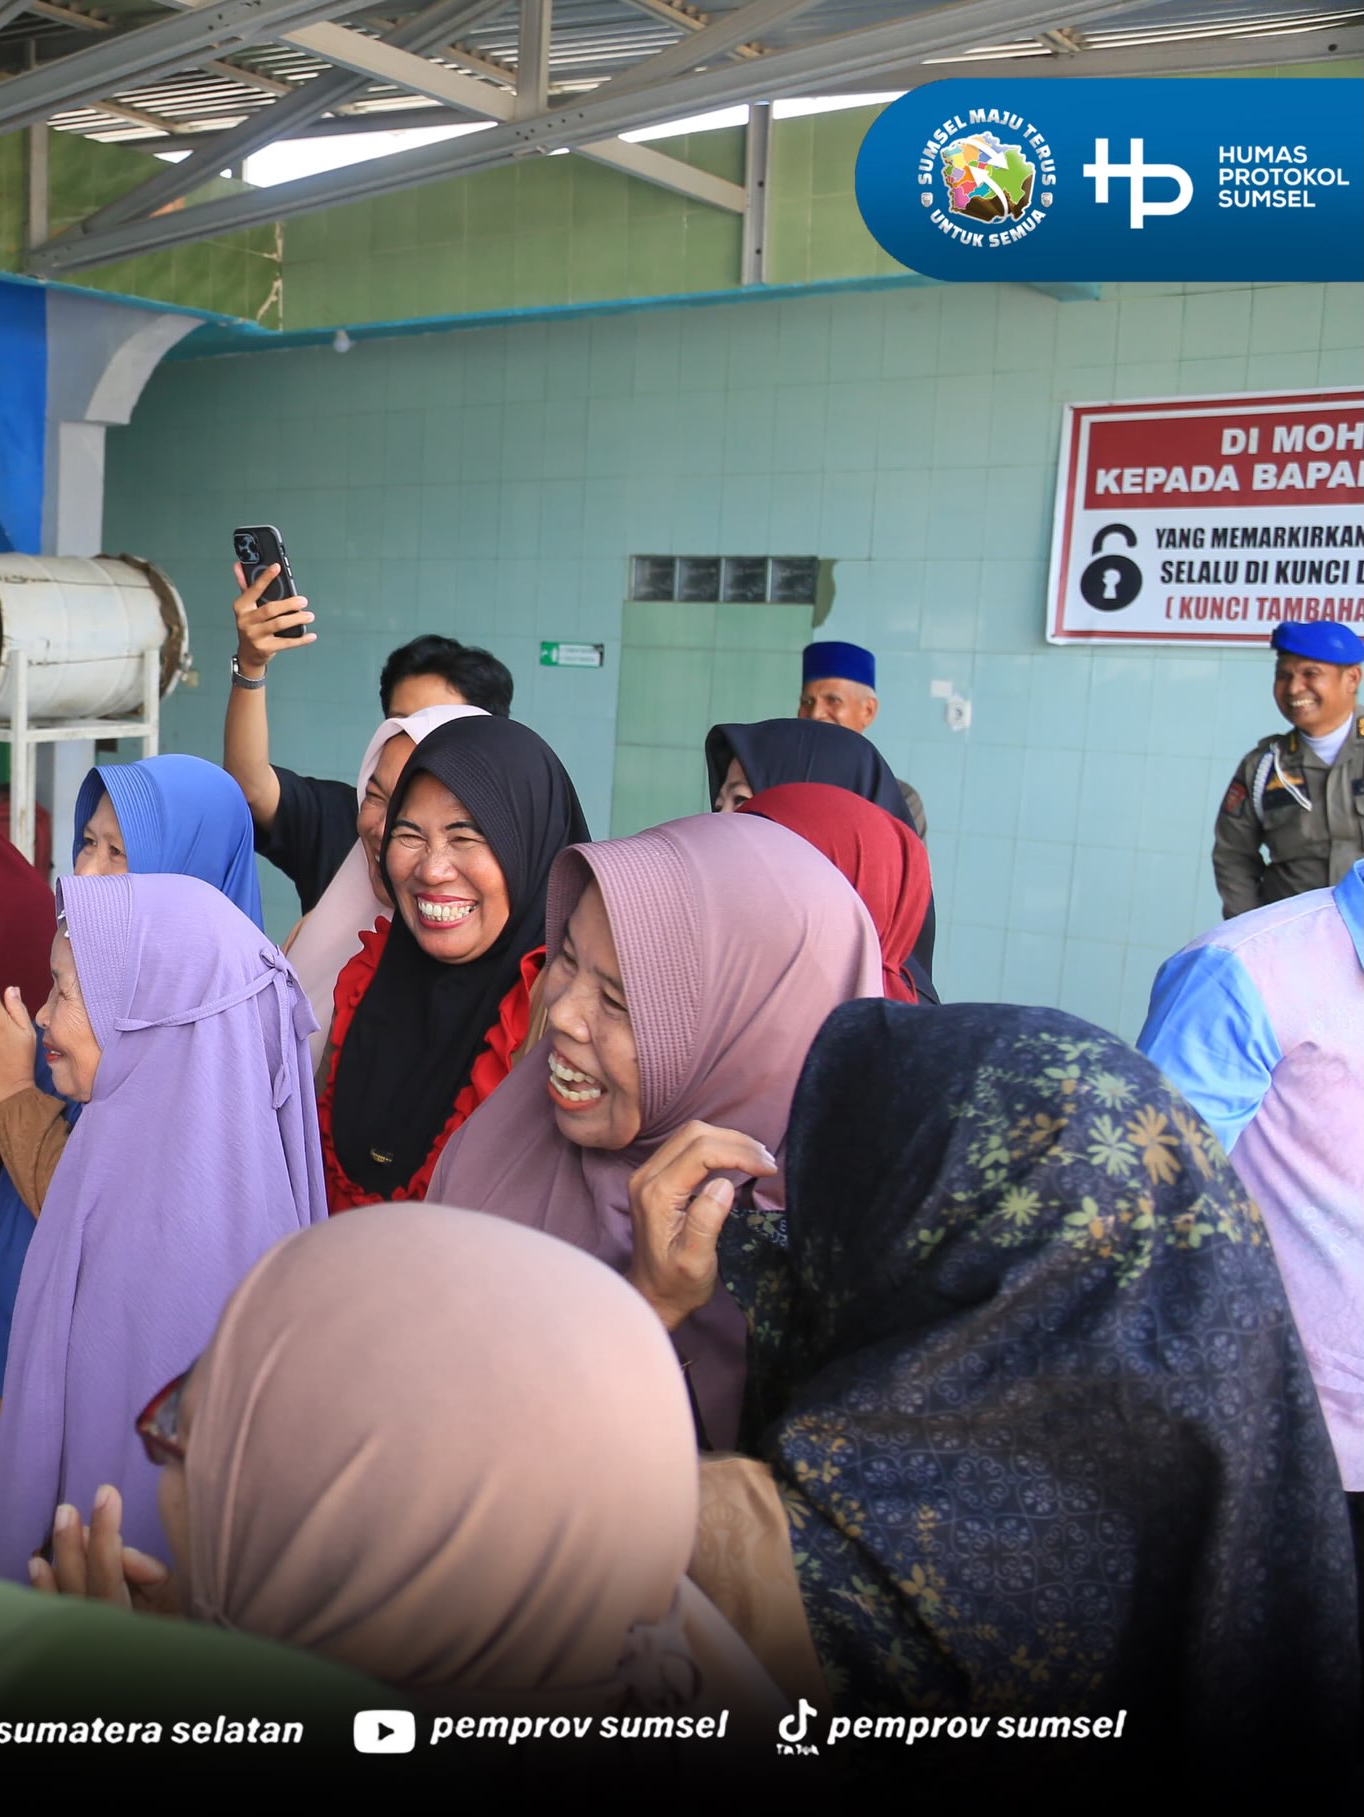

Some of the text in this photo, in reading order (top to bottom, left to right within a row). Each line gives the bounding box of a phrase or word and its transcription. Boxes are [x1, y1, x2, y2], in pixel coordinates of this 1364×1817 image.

[1220, 422, 1364, 455] DI MOH
[1095, 460, 1364, 494] KEPADA BAPA
[1155, 527, 1205, 549] YANG
[1160, 561, 1238, 584] SELALU
[1245, 561, 1268, 584] DI
[1275, 560, 1350, 585] KUNCI
[1179, 596, 1249, 620] KUNCI
